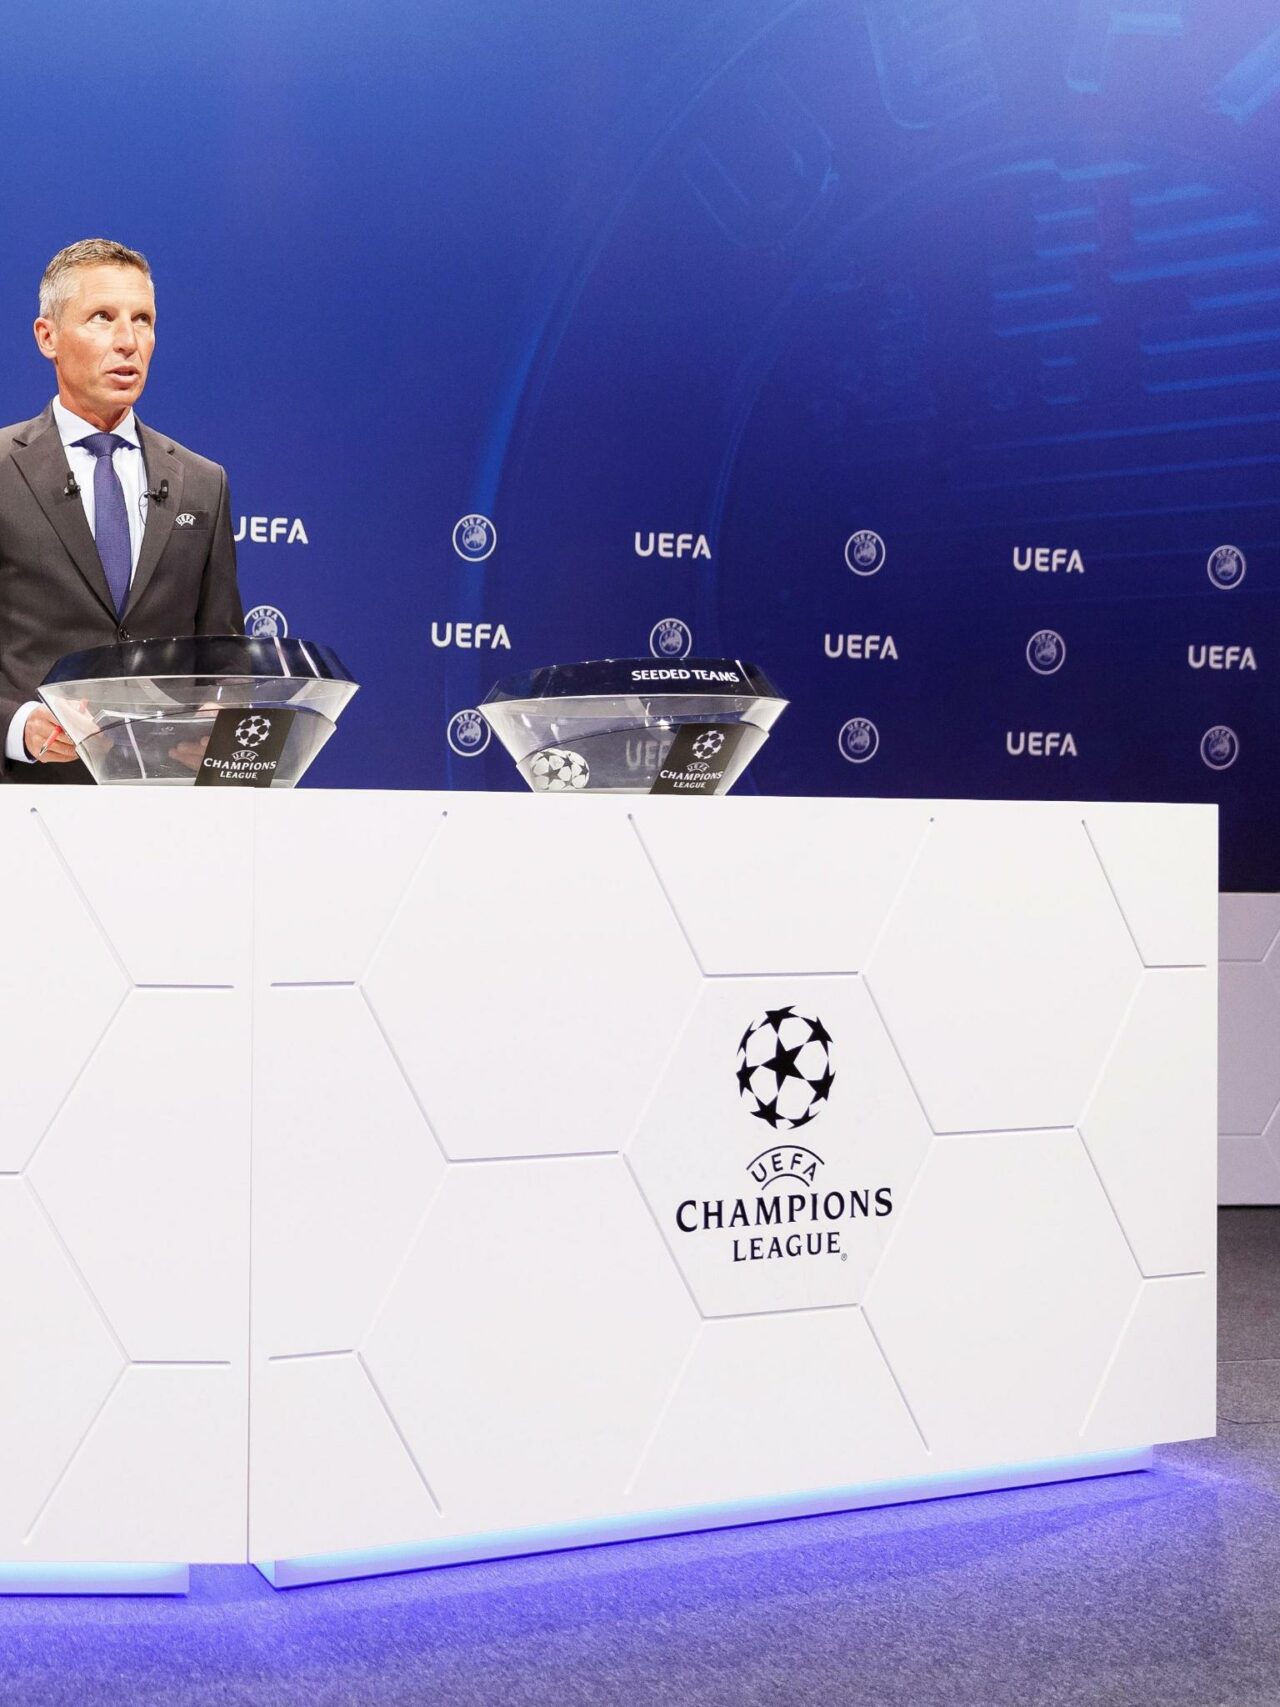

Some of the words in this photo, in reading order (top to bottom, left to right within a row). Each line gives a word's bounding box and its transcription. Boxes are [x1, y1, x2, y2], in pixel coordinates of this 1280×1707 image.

[175, 514, 196, 526] UEFA
[634, 532, 712, 559] UEFA
[1013, 547, 1085, 573] UEFA
[432, 622, 512, 649] UEFA
[824, 634, 898, 660] UEFA
[1188, 646, 1257, 670] UEFA
[631, 669, 690, 680] SEEDED
[691, 669, 740, 682] TEAMS
[232, 751, 257, 761] UEFA
[1007, 732, 1078, 756] UEFA
[203, 757, 277, 772] CHAMPIONS
[219, 771, 258, 780] LEAGUE
[660, 769, 724, 781] CHAMPIONS
[687, 763, 708, 771] UEFA
[673, 781, 707, 789] LEAGUE
[751, 1152, 817, 1183] UEFA
[675, 1187, 893, 1233] CHAMPIONS
[733, 1231, 841, 1263] LEAGUE
